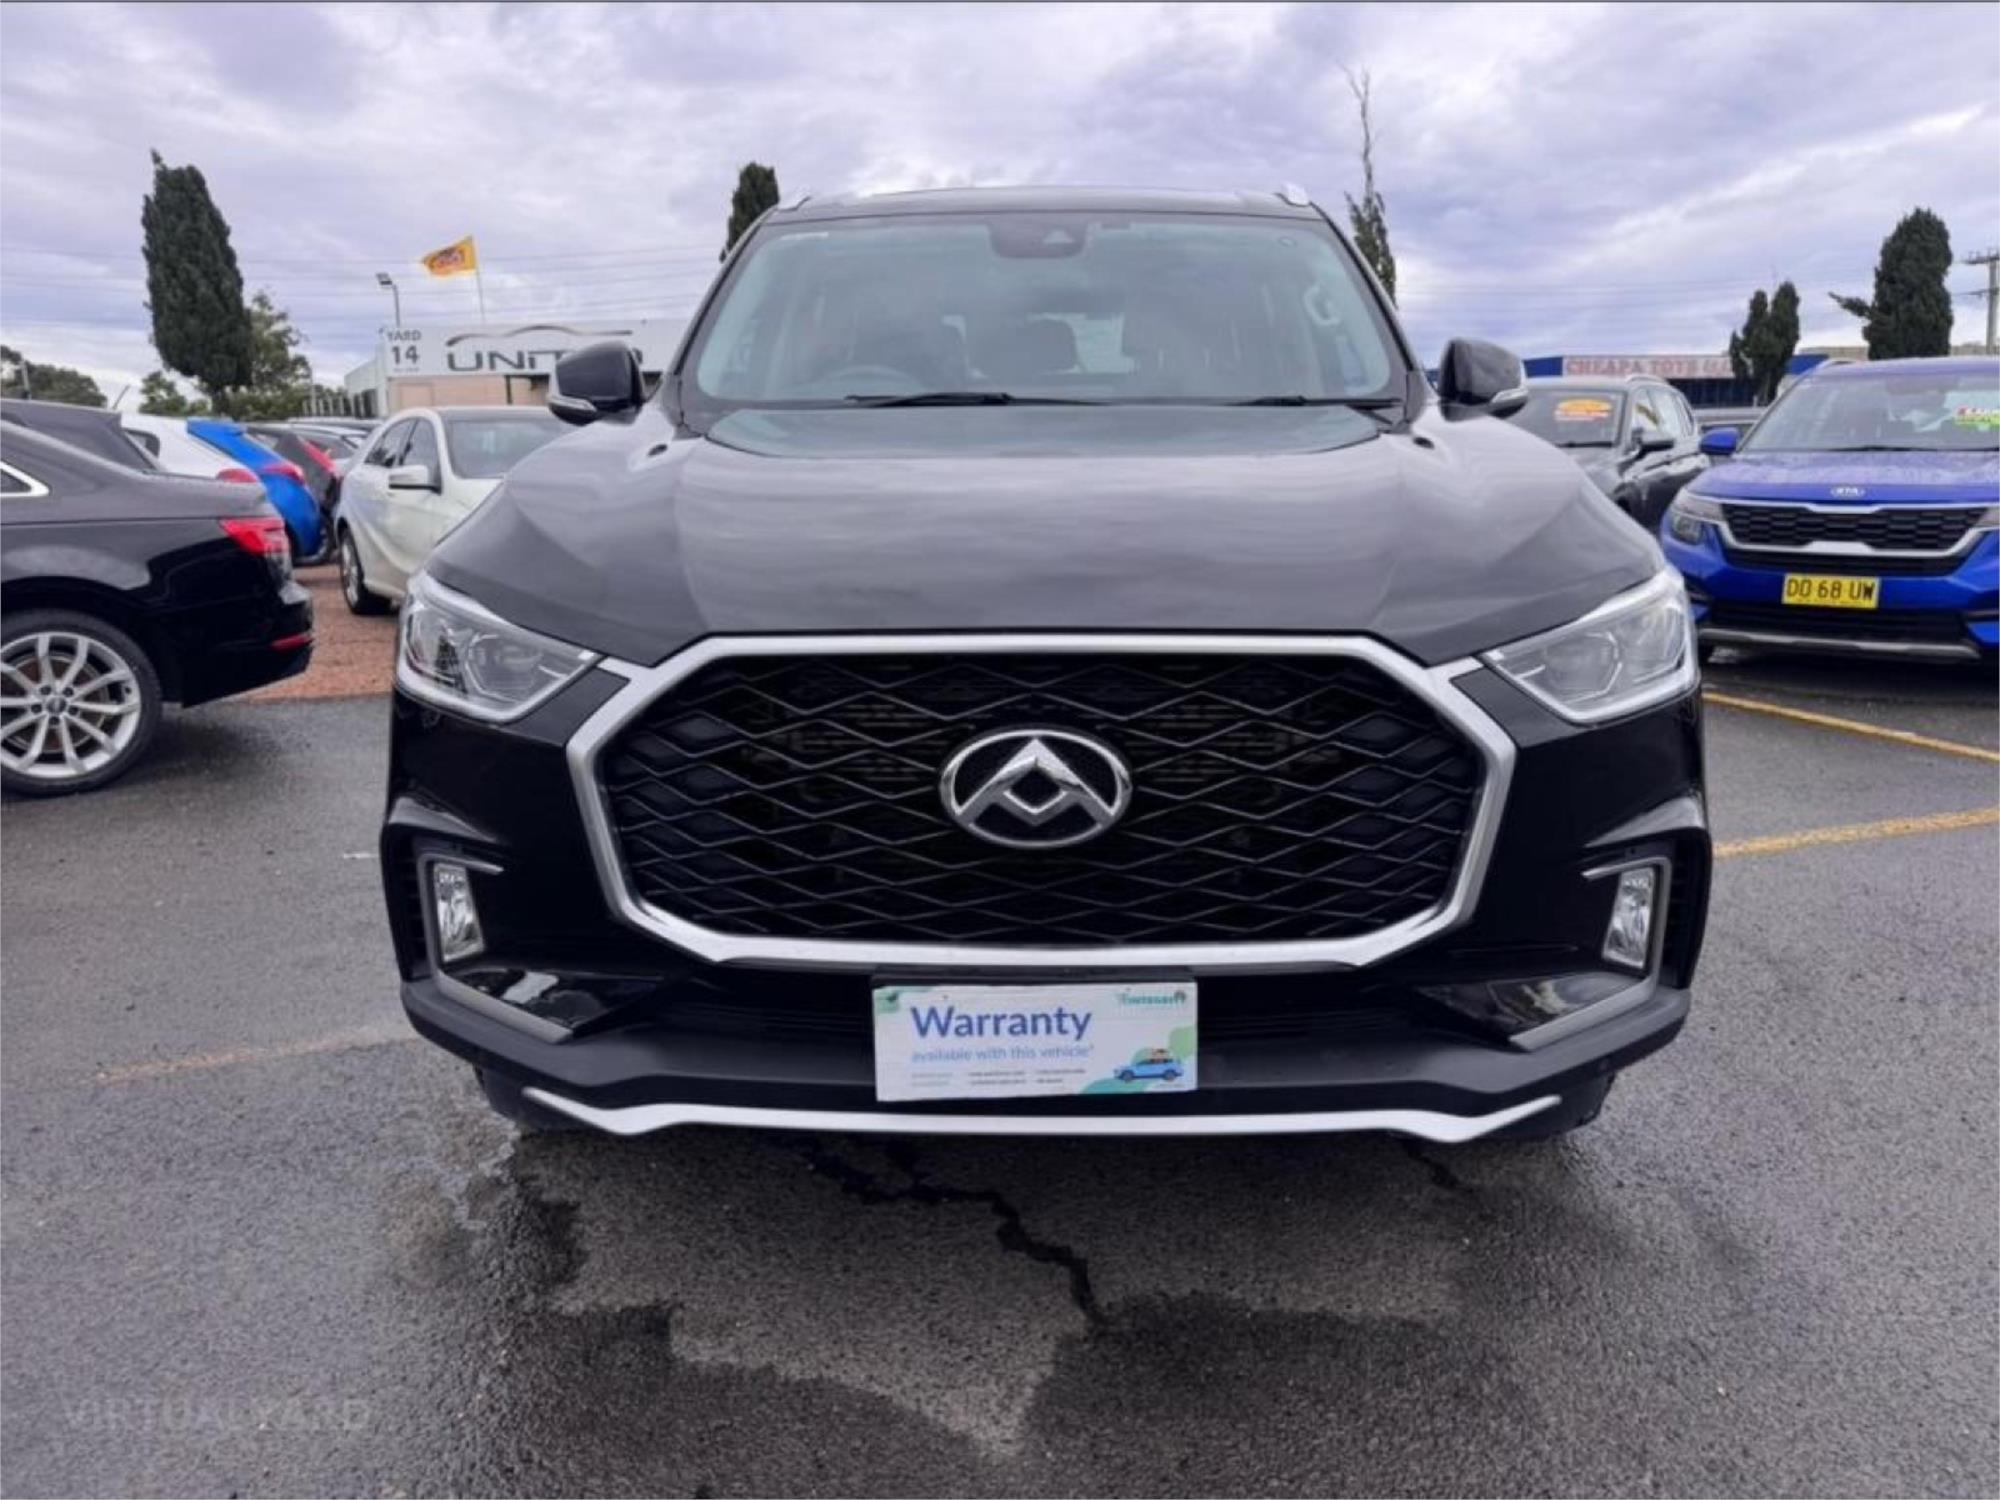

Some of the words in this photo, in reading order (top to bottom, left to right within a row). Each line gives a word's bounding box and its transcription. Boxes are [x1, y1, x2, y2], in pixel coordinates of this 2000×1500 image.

[386, 330, 422, 342] YARD
[392, 345, 420, 365] 14
[1817, 579, 1842, 599] 68
[1848, 580, 1876, 601] UW
[910, 1005, 1092, 1041] Warranty
[912, 1047, 970, 1062] available
[974, 1046, 1007, 1061] with
[1010, 1045, 1036, 1059] this
